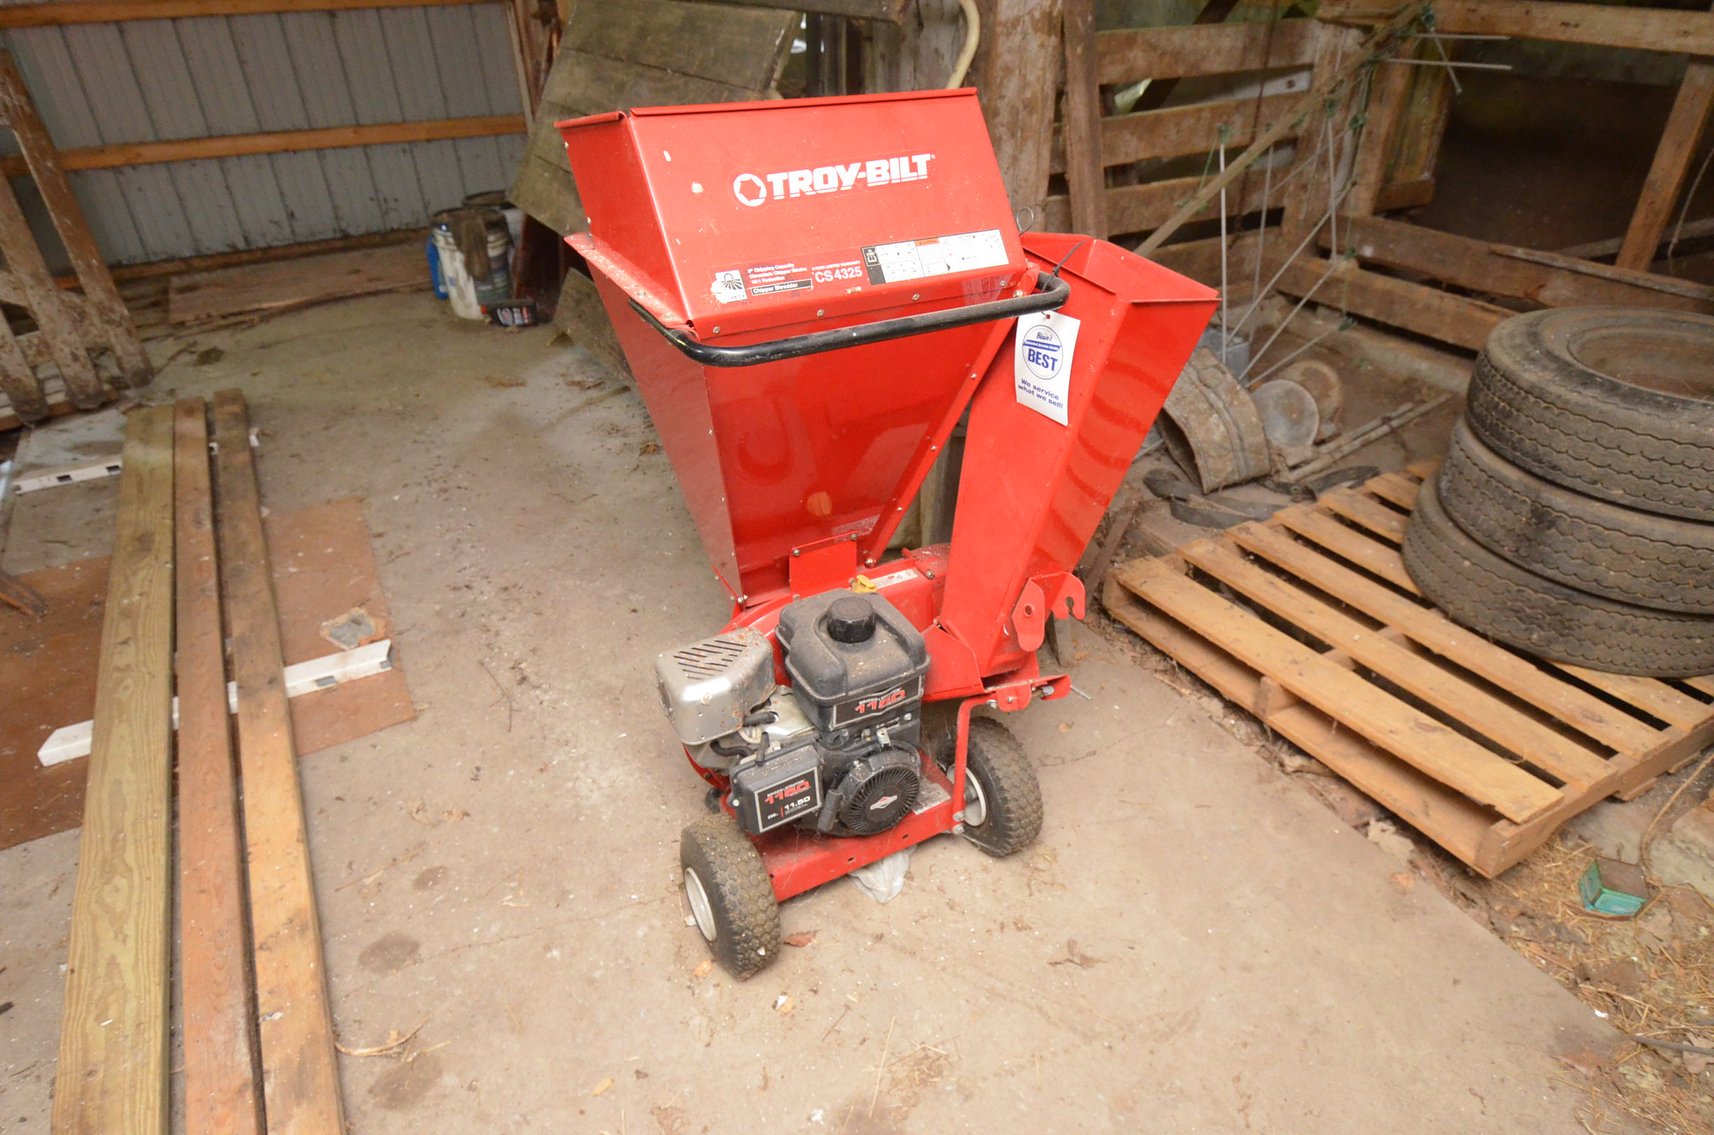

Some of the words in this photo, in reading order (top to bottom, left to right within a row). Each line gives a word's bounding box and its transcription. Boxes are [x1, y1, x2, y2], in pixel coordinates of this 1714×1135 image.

[767, 153, 932, 200] TROY-BILT
[814, 270, 834, 283] CS
[834, 266, 863, 280] 4325
[753, 286, 774, 294] Chipper
[774, 283, 798, 291] Shredder
[1028, 348, 1058, 371] BEST
[1018, 384, 1035, 396] what
[1036, 393, 1047, 401] we
[1021, 378, 1031, 387] We
[1033, 385, 1059, 400] service
